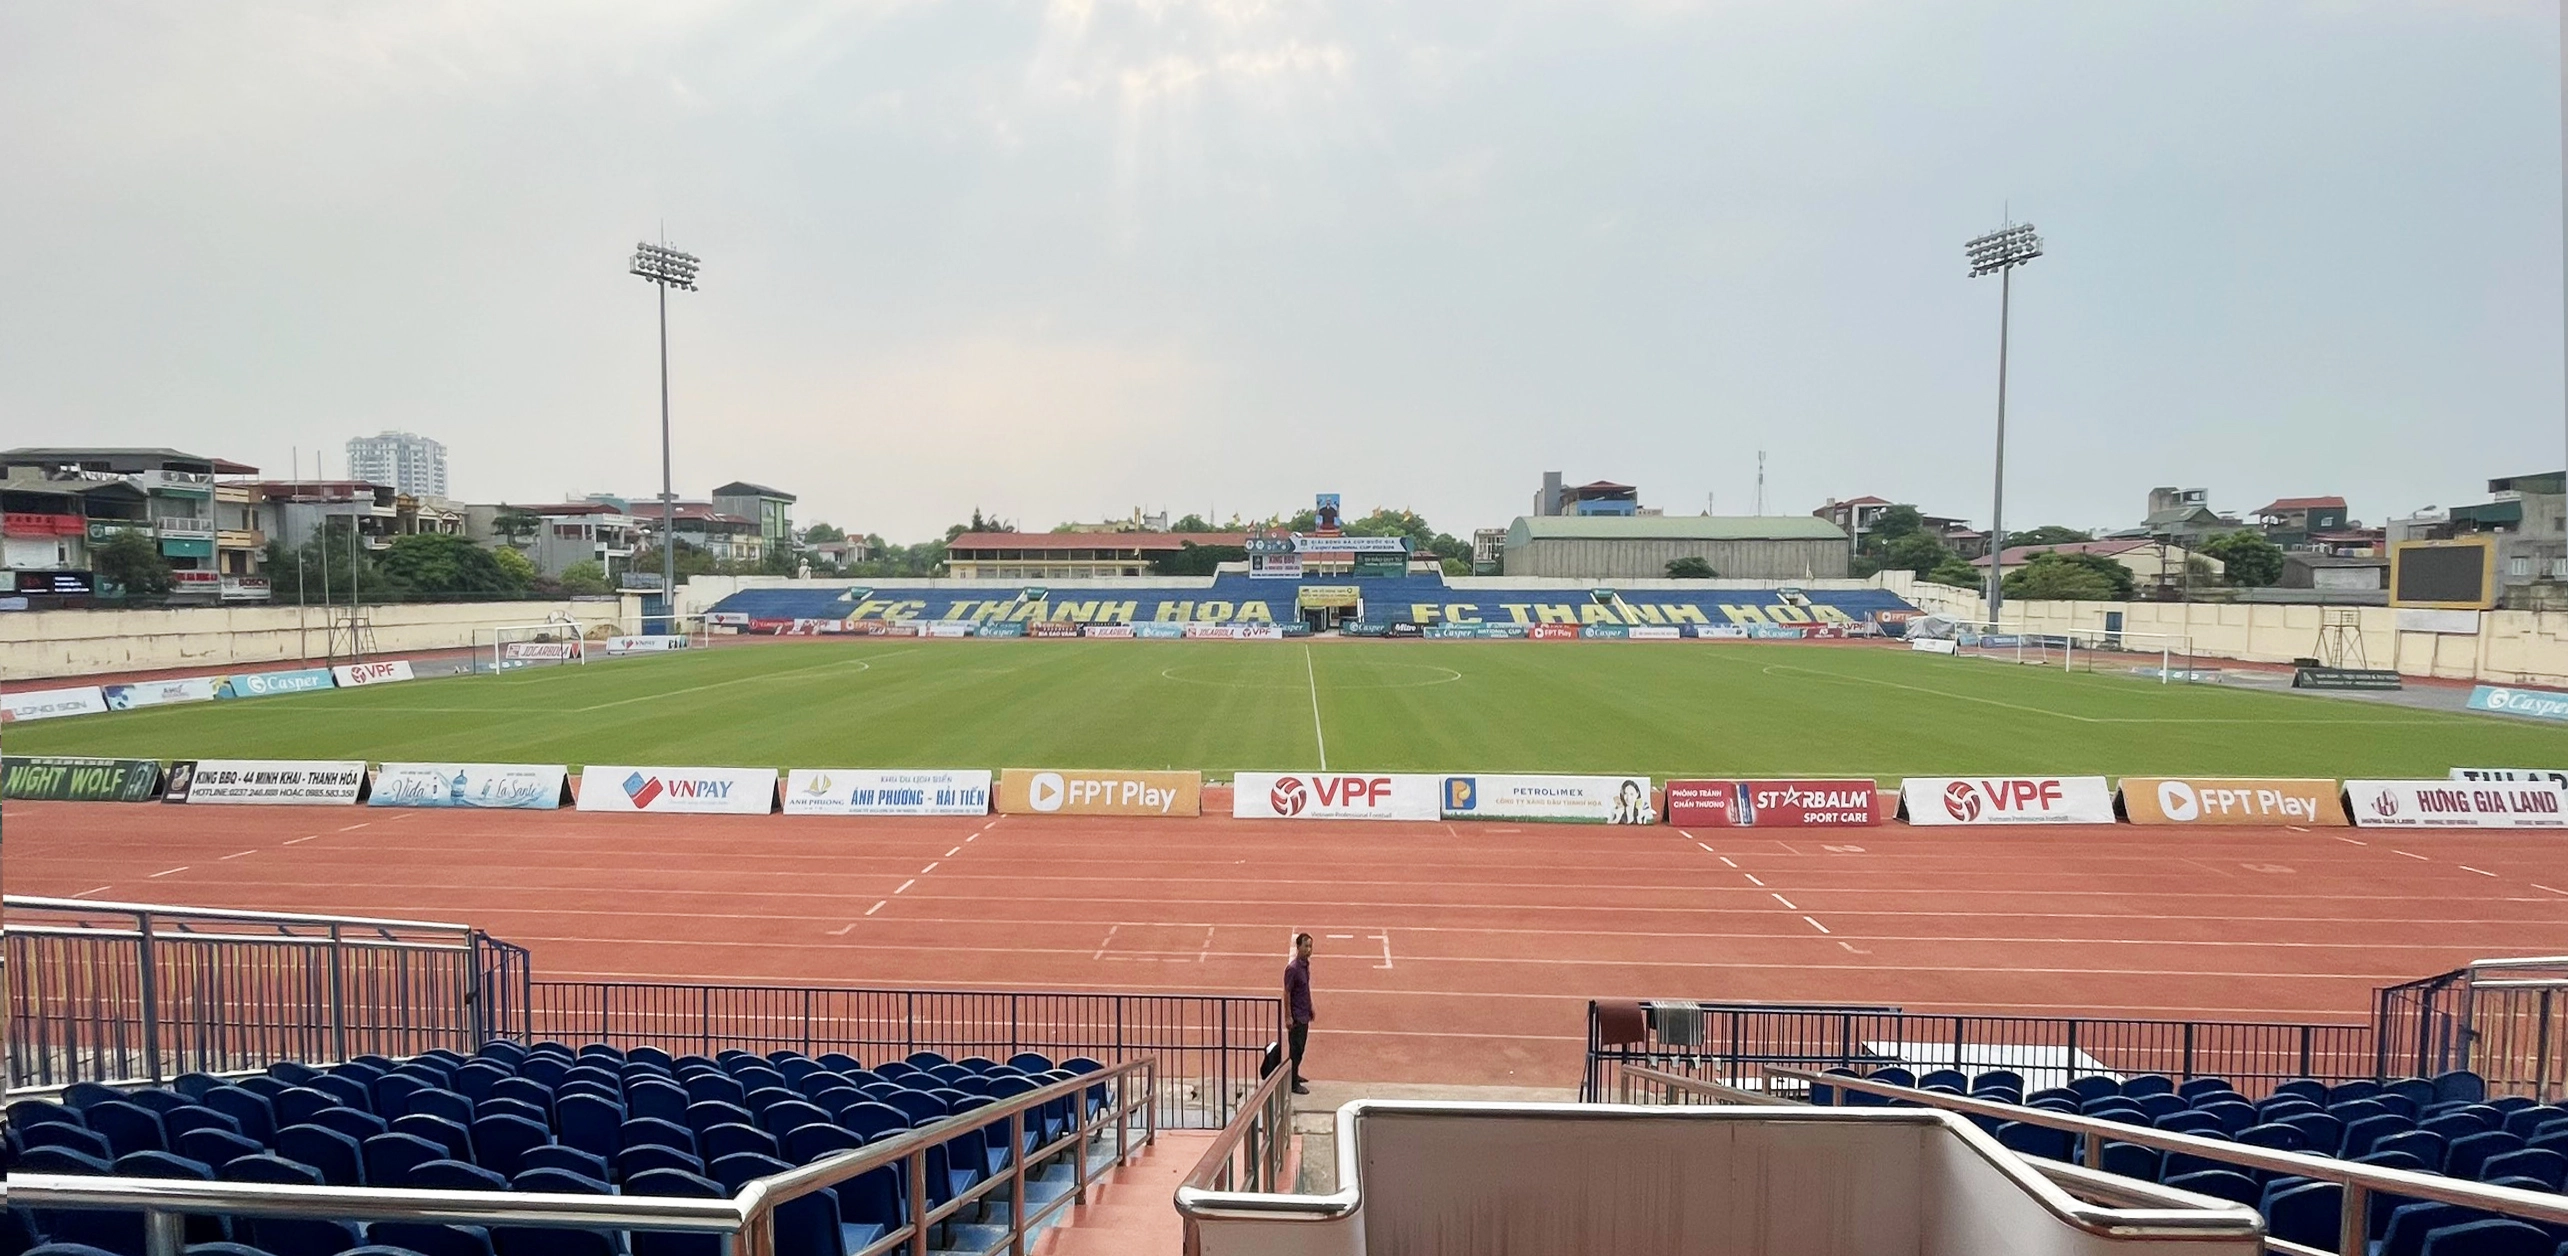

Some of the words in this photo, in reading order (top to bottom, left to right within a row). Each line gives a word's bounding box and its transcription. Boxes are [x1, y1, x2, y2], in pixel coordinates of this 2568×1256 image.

[238, 577, 269, 587] BOSCH
[847, 600, 927, 621] FC
[942, 600, 1138, 622] THANH
[1410, 603, 1483, 624] FC
[1499, 603, 1710, 625] THANH
[1252, 627, 1272, 636] VPF
[1358, 623, 1385, 633] Casper
[1443, 629, 1472, 638] Casper
[1544, 629, 1557, 637] FPT
[1557, 629, 1572, 638] Play
[1594, 628, 1622, 639] Casper
[364, 663, 395, 679] VPF
[267, 674, 320, 691] Casper
[14, 704, 55, 716] LONG
[6, 765, 69, 793] NIGHT
[70, 767, 127, 795] WOLF
[195, 771, 219, 785] KING
[219, 771, 238, 785] BBQ
[255, 771, 279, 785] MINH
[279, 772, 302, 785] KHAI
[308, 772, 339, 785] THANH
[339, 769, 358, 785] HÓA
[393, 778, 426, 801] Vida
[496, 779, 508, 799] La
[668, 780, 734, 799] VNPAY
[878, 787, 924, 806] PHƯƠNG
[936, 785, 956, 806] HẢI
[959, 786, 985, 806] TIẾN
[1068, 780, 1119, 806] FPT
[1122, 780, 1178, 814] Play
[1312, 777, 1393, 808] VPF
[1513, 788, 1584, 797] PETROLIMEX
[1672, 788, 1699, 798] PHÒNG
[1699, 789, 1722, 798] TRÁNH
[1756, 785, 1868, 809] STARBALM
[1981, 780, 2063, 811] VPF
[1495, 797, 1515, 805] CÔNG
[1563, 798, 1586, 807] THANH
[2199, 788, 2252, 815] FPT
[2255, 789, 2317, 823] Play
[2416, 788, 2471, 813] HƯNG
[2473, 791, 2507, 814] GIA
[2508, 791, 2559, 814] LAND
[1803, 812, 1841, 824] SPORT
[1841, 811, 1869, 823] CARE
